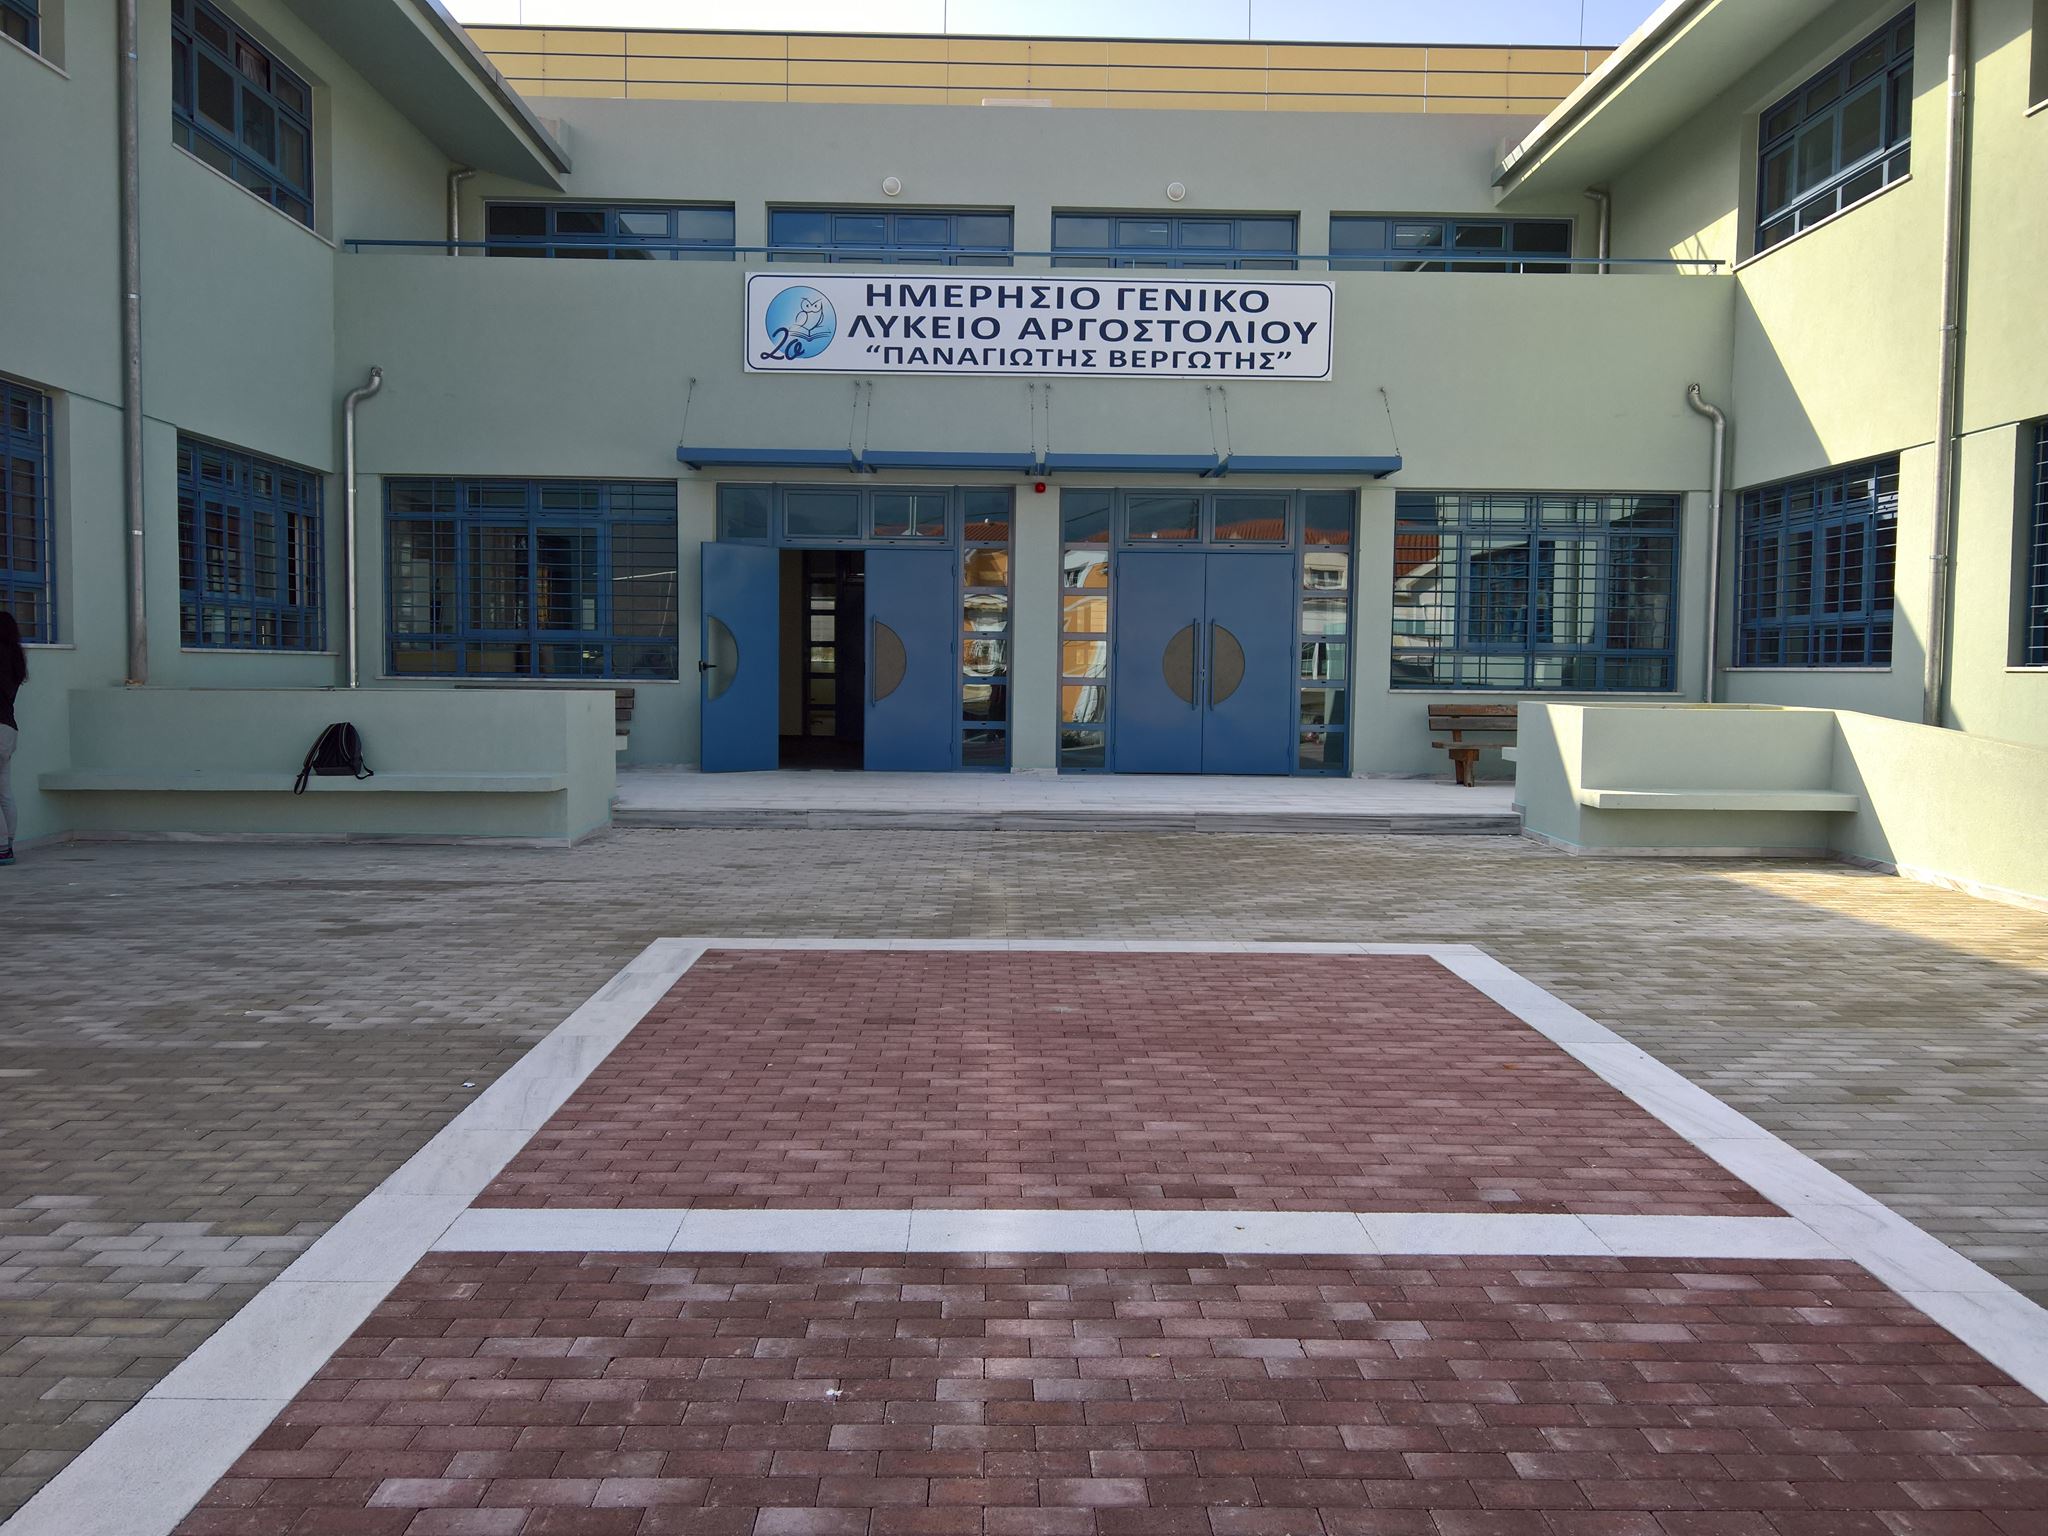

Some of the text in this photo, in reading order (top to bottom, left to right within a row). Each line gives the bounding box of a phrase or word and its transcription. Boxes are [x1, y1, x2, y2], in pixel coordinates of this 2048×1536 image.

[866, 283, 1270, 314] ΗΜΕΡΗΣΙΟ ΓΕΝΙΚΟ
[847, 314, 1318, 345] ΛΥΚΕΙΟ ΑΡΓΟΣΤΟΛΙΟΥ
